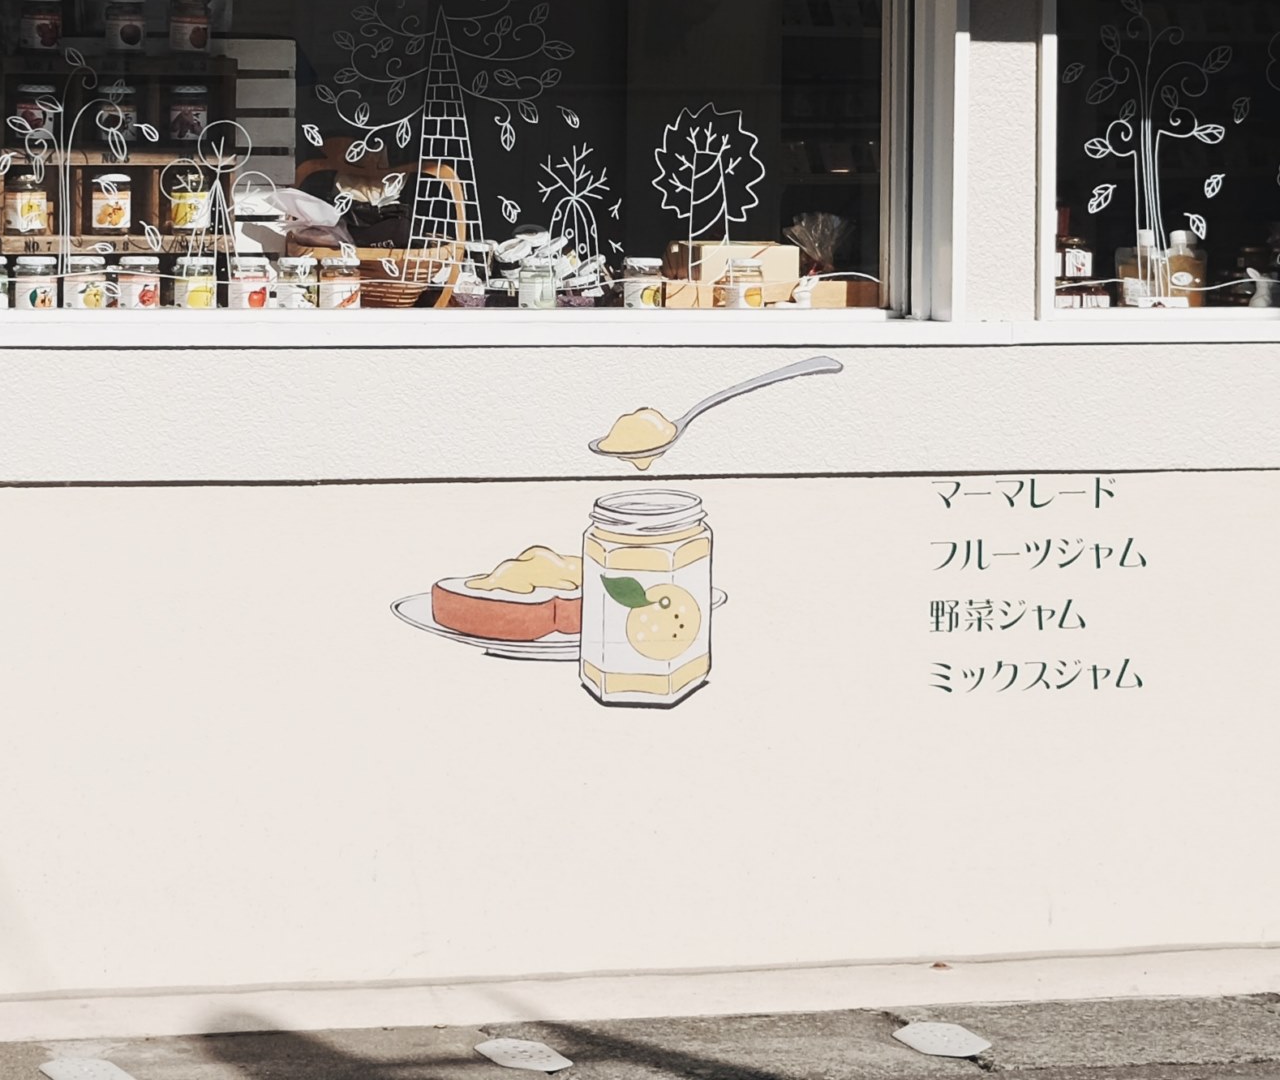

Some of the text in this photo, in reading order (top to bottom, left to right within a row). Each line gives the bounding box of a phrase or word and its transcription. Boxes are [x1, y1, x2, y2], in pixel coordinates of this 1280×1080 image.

[931, 477, 1116, 509] マーマレード
[930, 537, 1147, 571] フルーツジャム
[929, 599, 1087, 632] 野菜ジャム
[928, 658, 1144, 693] ミックスジャム
